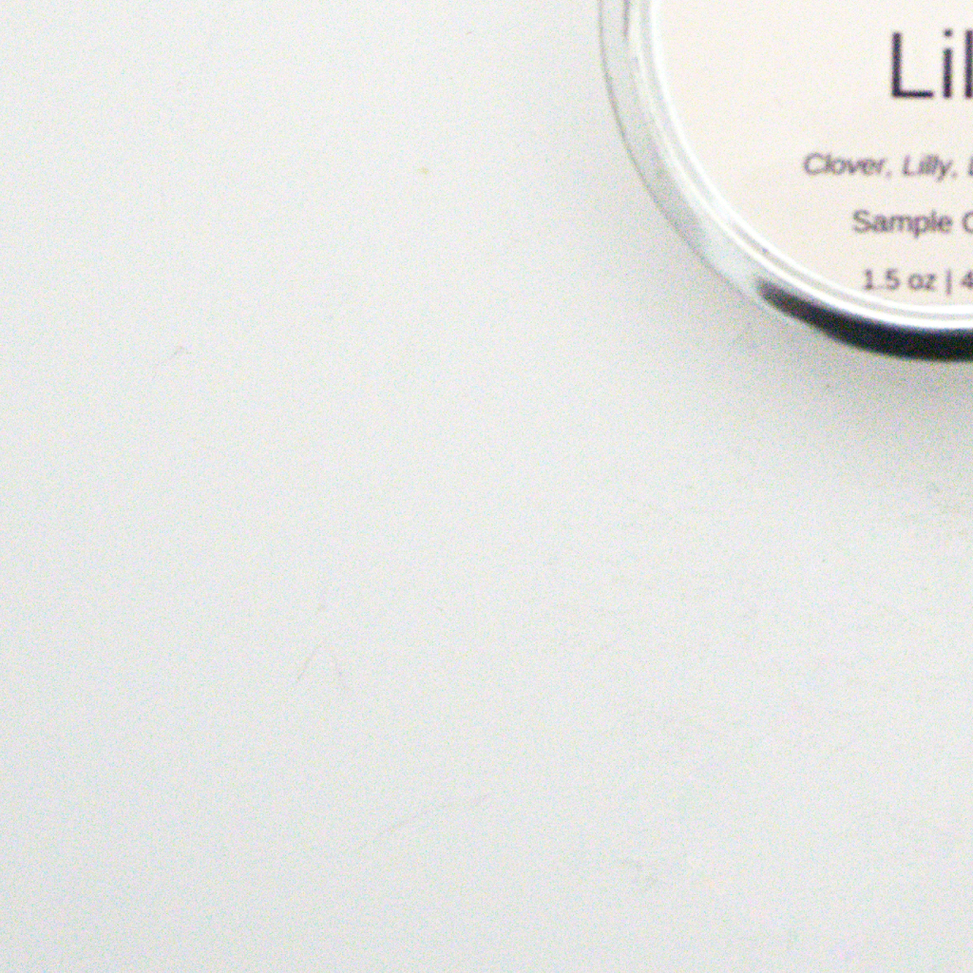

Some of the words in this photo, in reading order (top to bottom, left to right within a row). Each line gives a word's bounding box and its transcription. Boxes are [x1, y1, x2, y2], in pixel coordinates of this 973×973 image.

[803, 152, 893, 179] Clover,
[902, 155, 959, 183] Lilly,
[852, 209, 954, 238] Sample
[863, 268, 901, 291] 1.5
[907, 273, 937, 292] oz
